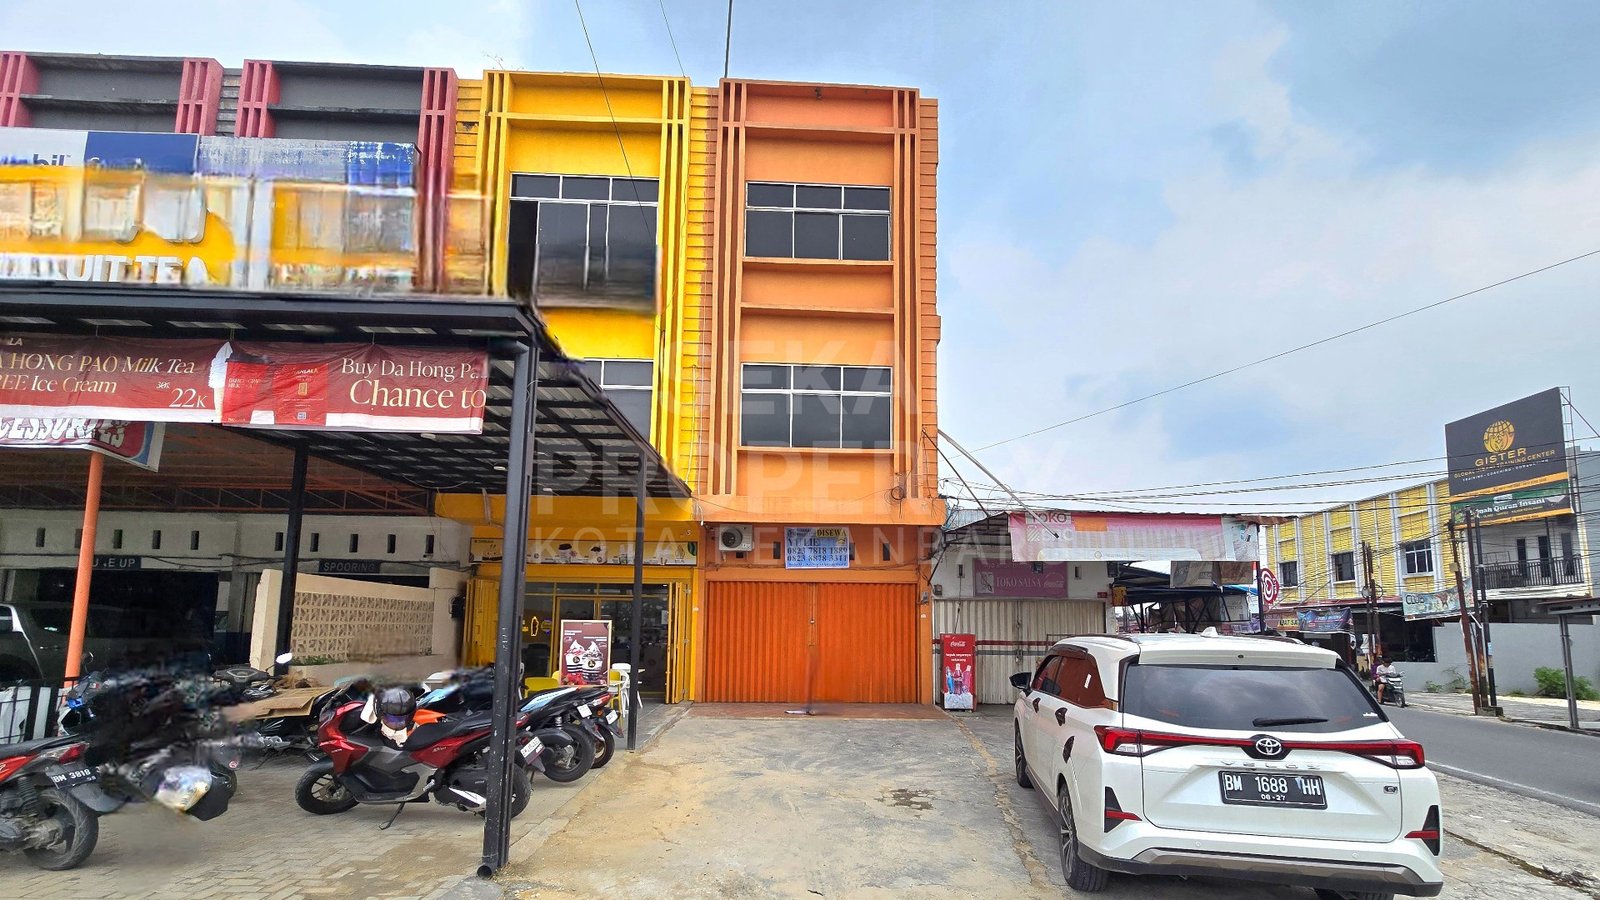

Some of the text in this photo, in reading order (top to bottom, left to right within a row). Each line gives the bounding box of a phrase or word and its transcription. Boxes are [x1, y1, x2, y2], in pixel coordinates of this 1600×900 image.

[10, 352, 74, 371] HONG
[79, 355, 118, 373] PAO
[122, 357, 161, 373] Milk
[167, 358, 196, 374] Tea
[341, 357, 377, 378] Buy
[381, 360, 404, 376] Da
[409, 361, 456, 382] Hong
[31, 375, 58, 392] Ice
[62, 377, 117, 393] Cream
[349, 379, 487, 409] Chance to
[168, 388, 208, 408] 22K
[1475, 447, 1527, 467] GISTER
[1527, 449, 1556, 461] CENTER
[816, 528, 847, 537] DISEWA
[120, 559, 136, 568] UP
[323, 562, 376, 572] SPOORING
[1224, 774, 1321, 796] BM 1688 HH
